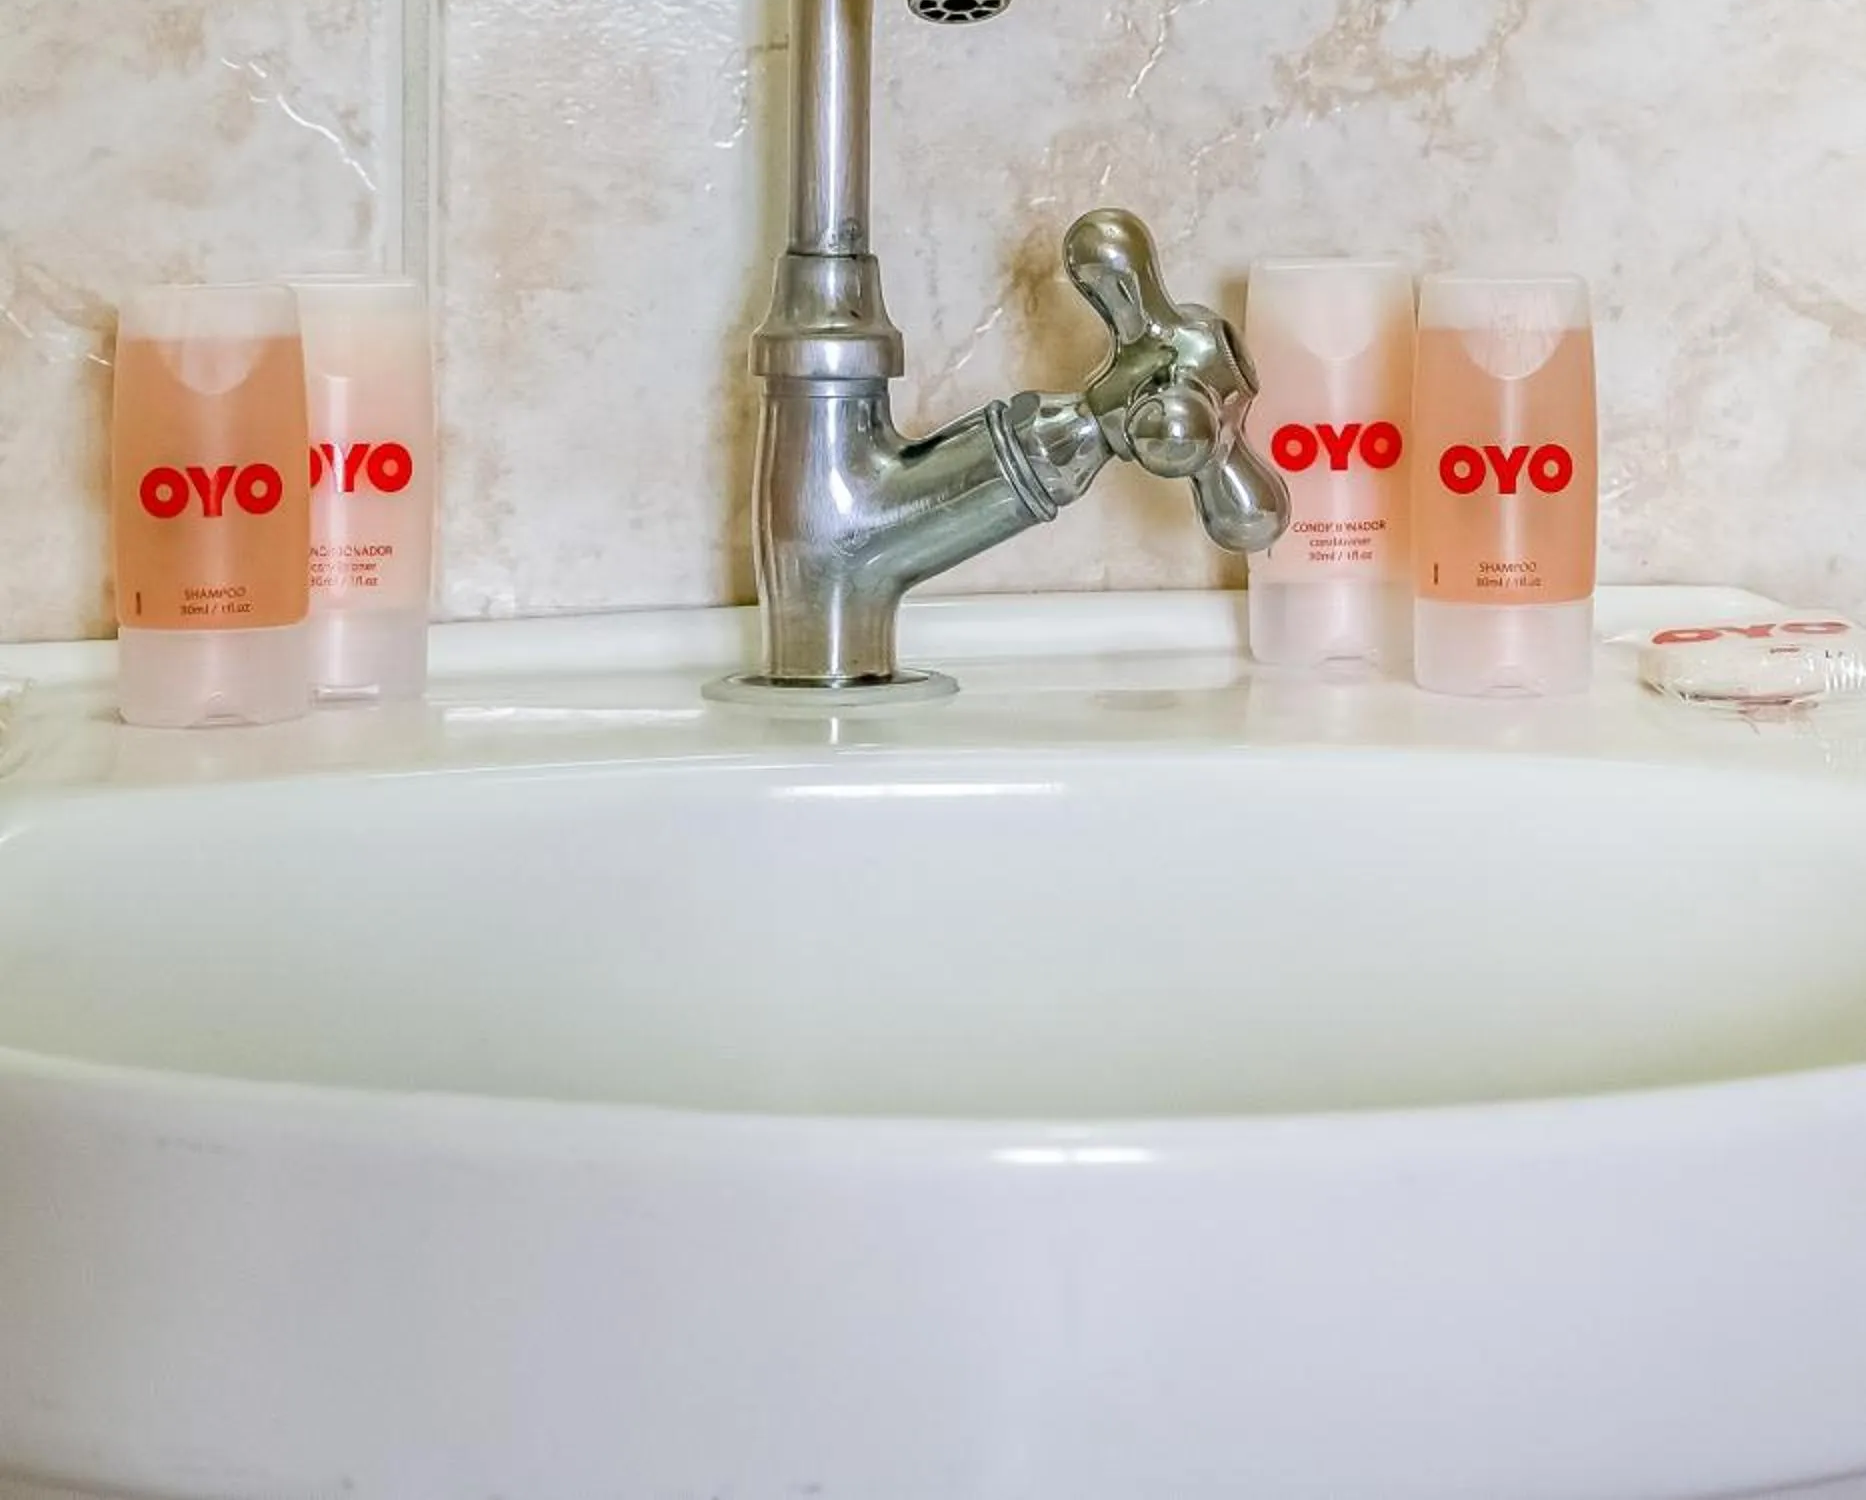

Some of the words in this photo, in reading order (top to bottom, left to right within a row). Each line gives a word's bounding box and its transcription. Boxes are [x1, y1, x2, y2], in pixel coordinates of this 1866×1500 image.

[1271, 421, 1402, 472] OYO
[309, 443, 413, 493] YO
[1439, 444, 1573, 494] OYO
[139, 463, 283, 518] OYO
[309, 545, 393, 557] NDIONADOR
[311, 561, 377, 573] cononer
[1479, 561, 1537, 573] SHAMPOO
[184, 586, 247, 601] SHAMPOO
[1652, 622, 1849, 645] OYO
